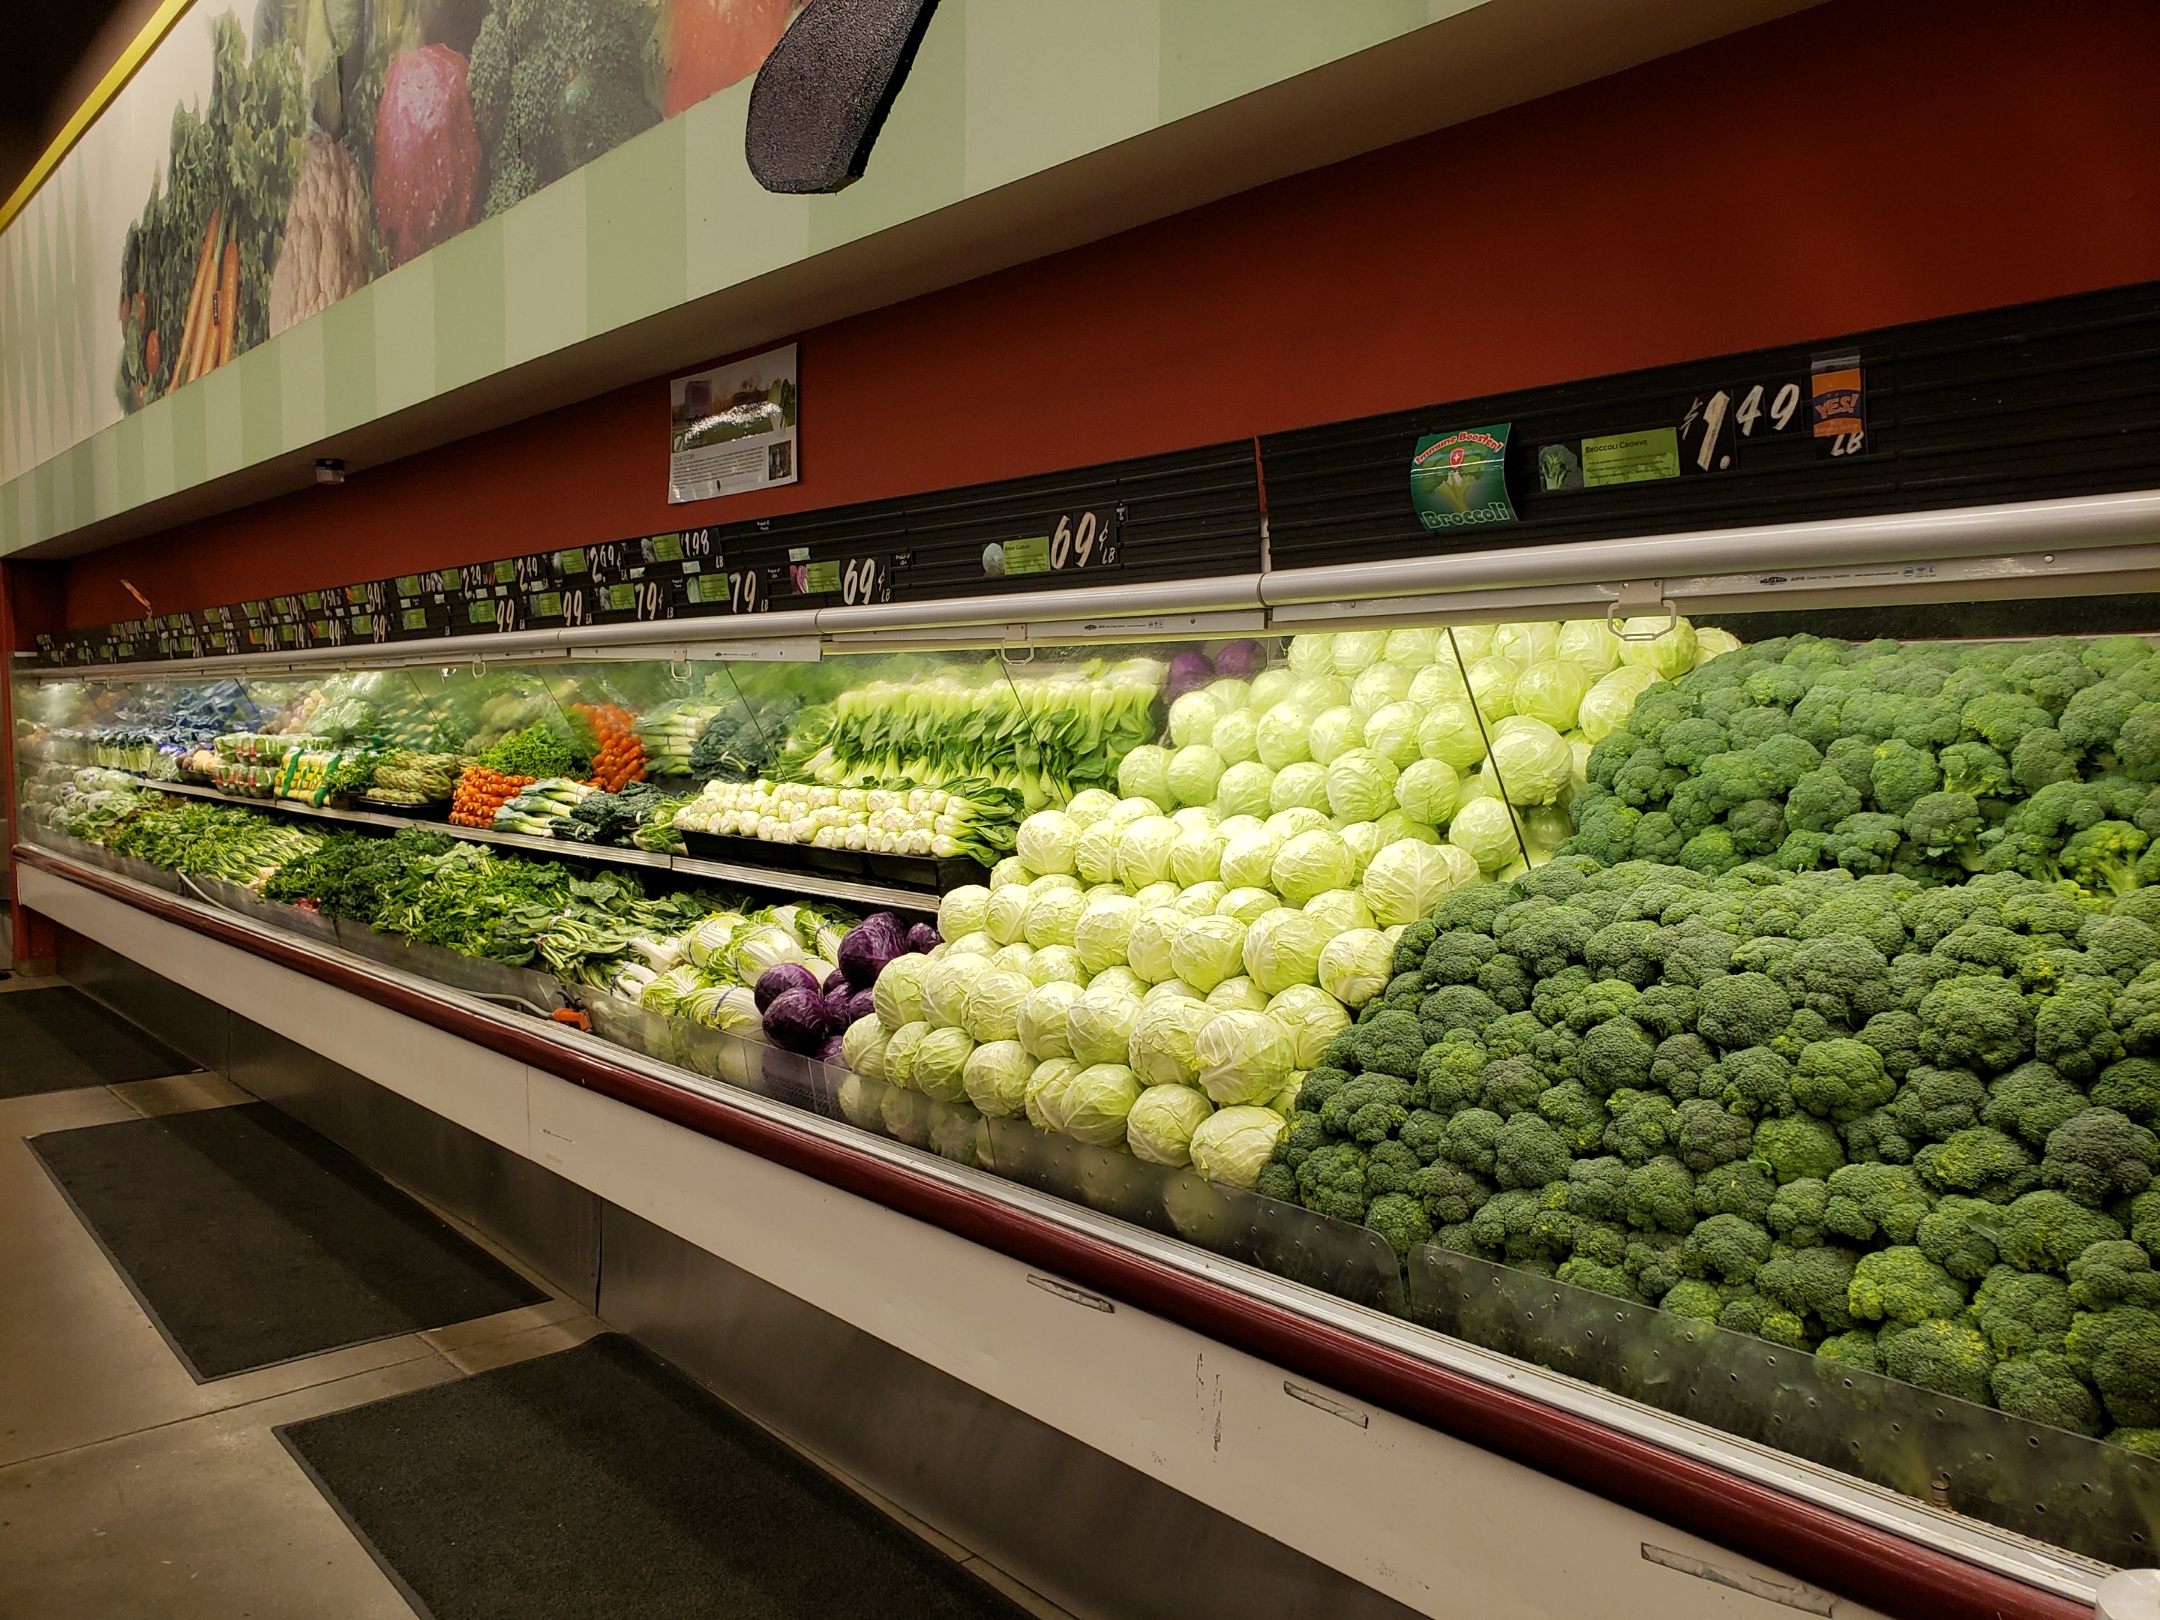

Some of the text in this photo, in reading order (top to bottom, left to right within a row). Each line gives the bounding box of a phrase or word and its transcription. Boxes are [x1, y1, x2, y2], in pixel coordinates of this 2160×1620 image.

[1814, 393, 1860, 419] YES!
[1414, 431, 1505, 465] Immune Booster!
[1830, 431, 1865, 457] LB
[1421, 501, 1511, 529] Broccoli
[715, 554, 724, 569] LB
[1101, 547, 1116, 565] LB
[729, 570, 757, 614] 79
[760, 598, 769, 612] LB
[880, 588, 891, 604] LB
[496, 597, 515, 633] 99
[562, 589, 583, 627] 99
[666, 606, 675, 619] LB
